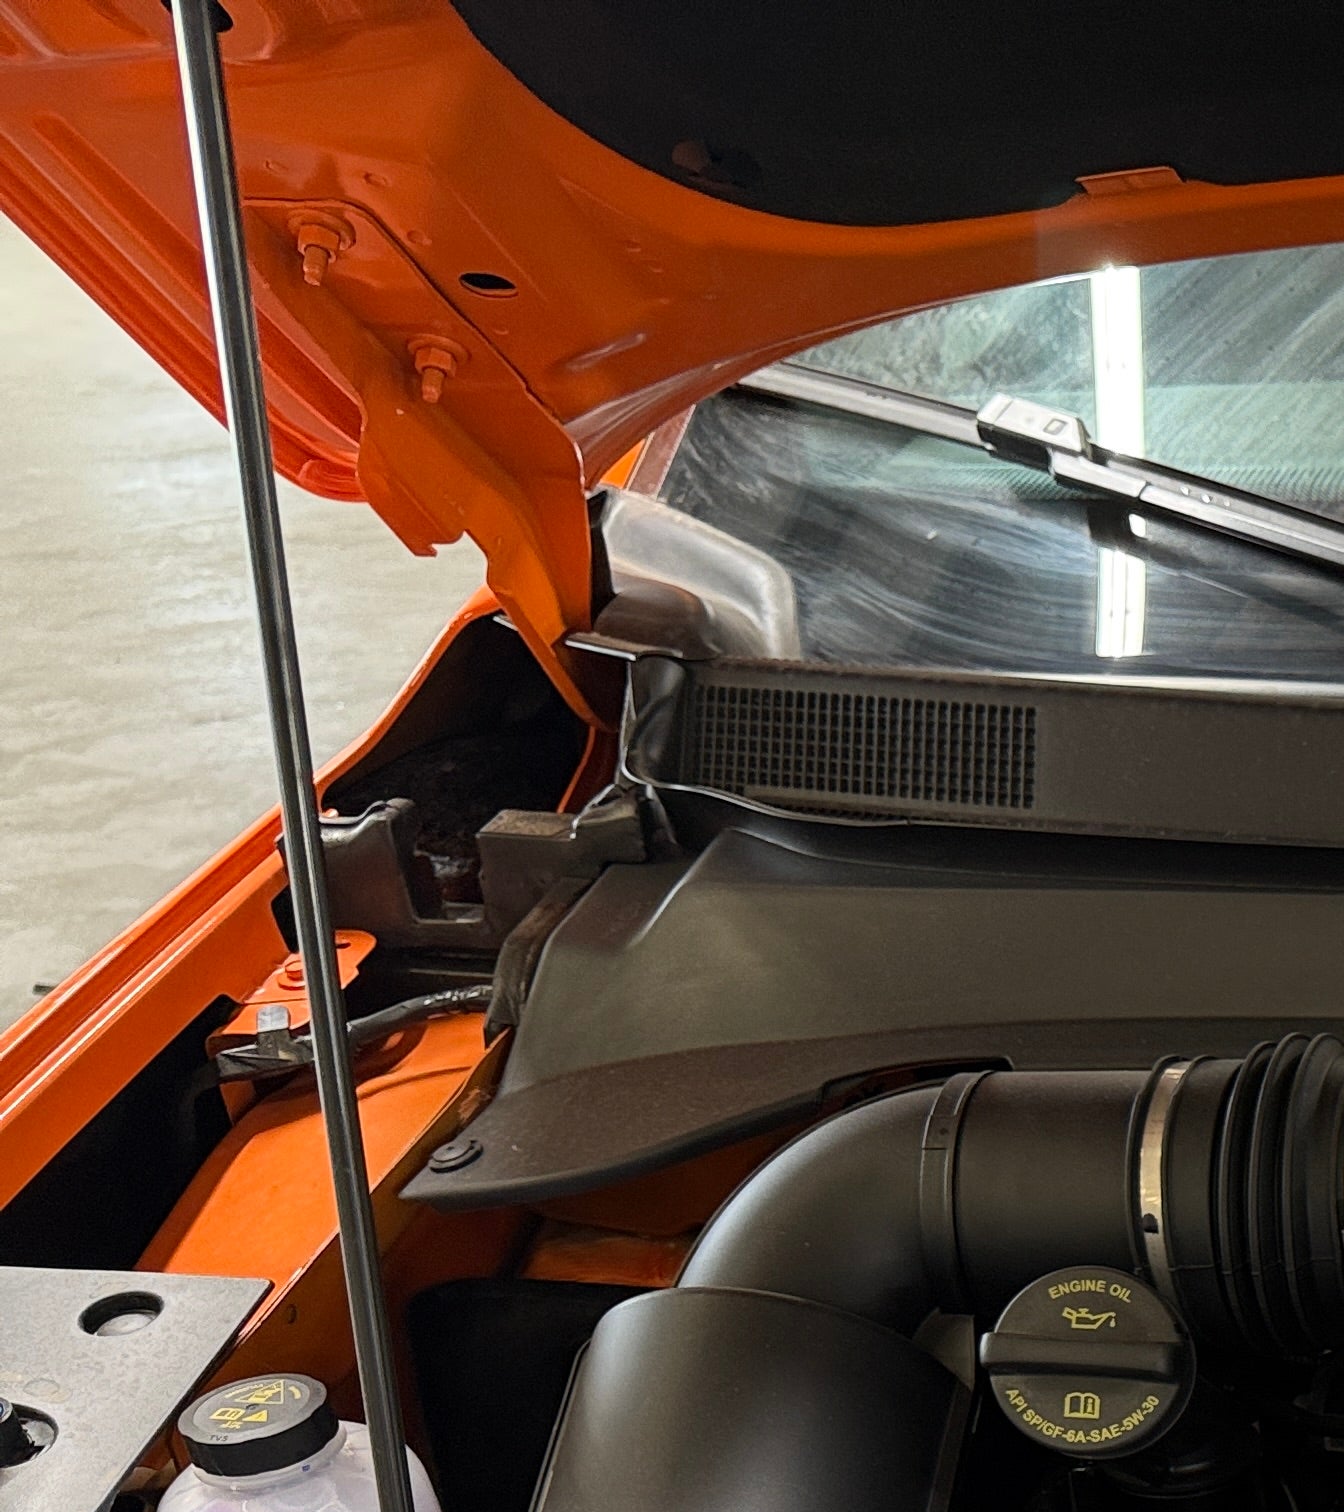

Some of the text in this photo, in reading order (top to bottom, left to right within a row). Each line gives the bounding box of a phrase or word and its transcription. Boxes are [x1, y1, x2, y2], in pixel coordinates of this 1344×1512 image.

[1048, 1279, 1132, 1303] ENGINE OIL
[1005, 1388, 1160, 1443] API SP/GF-6A-SAE-5W-30
